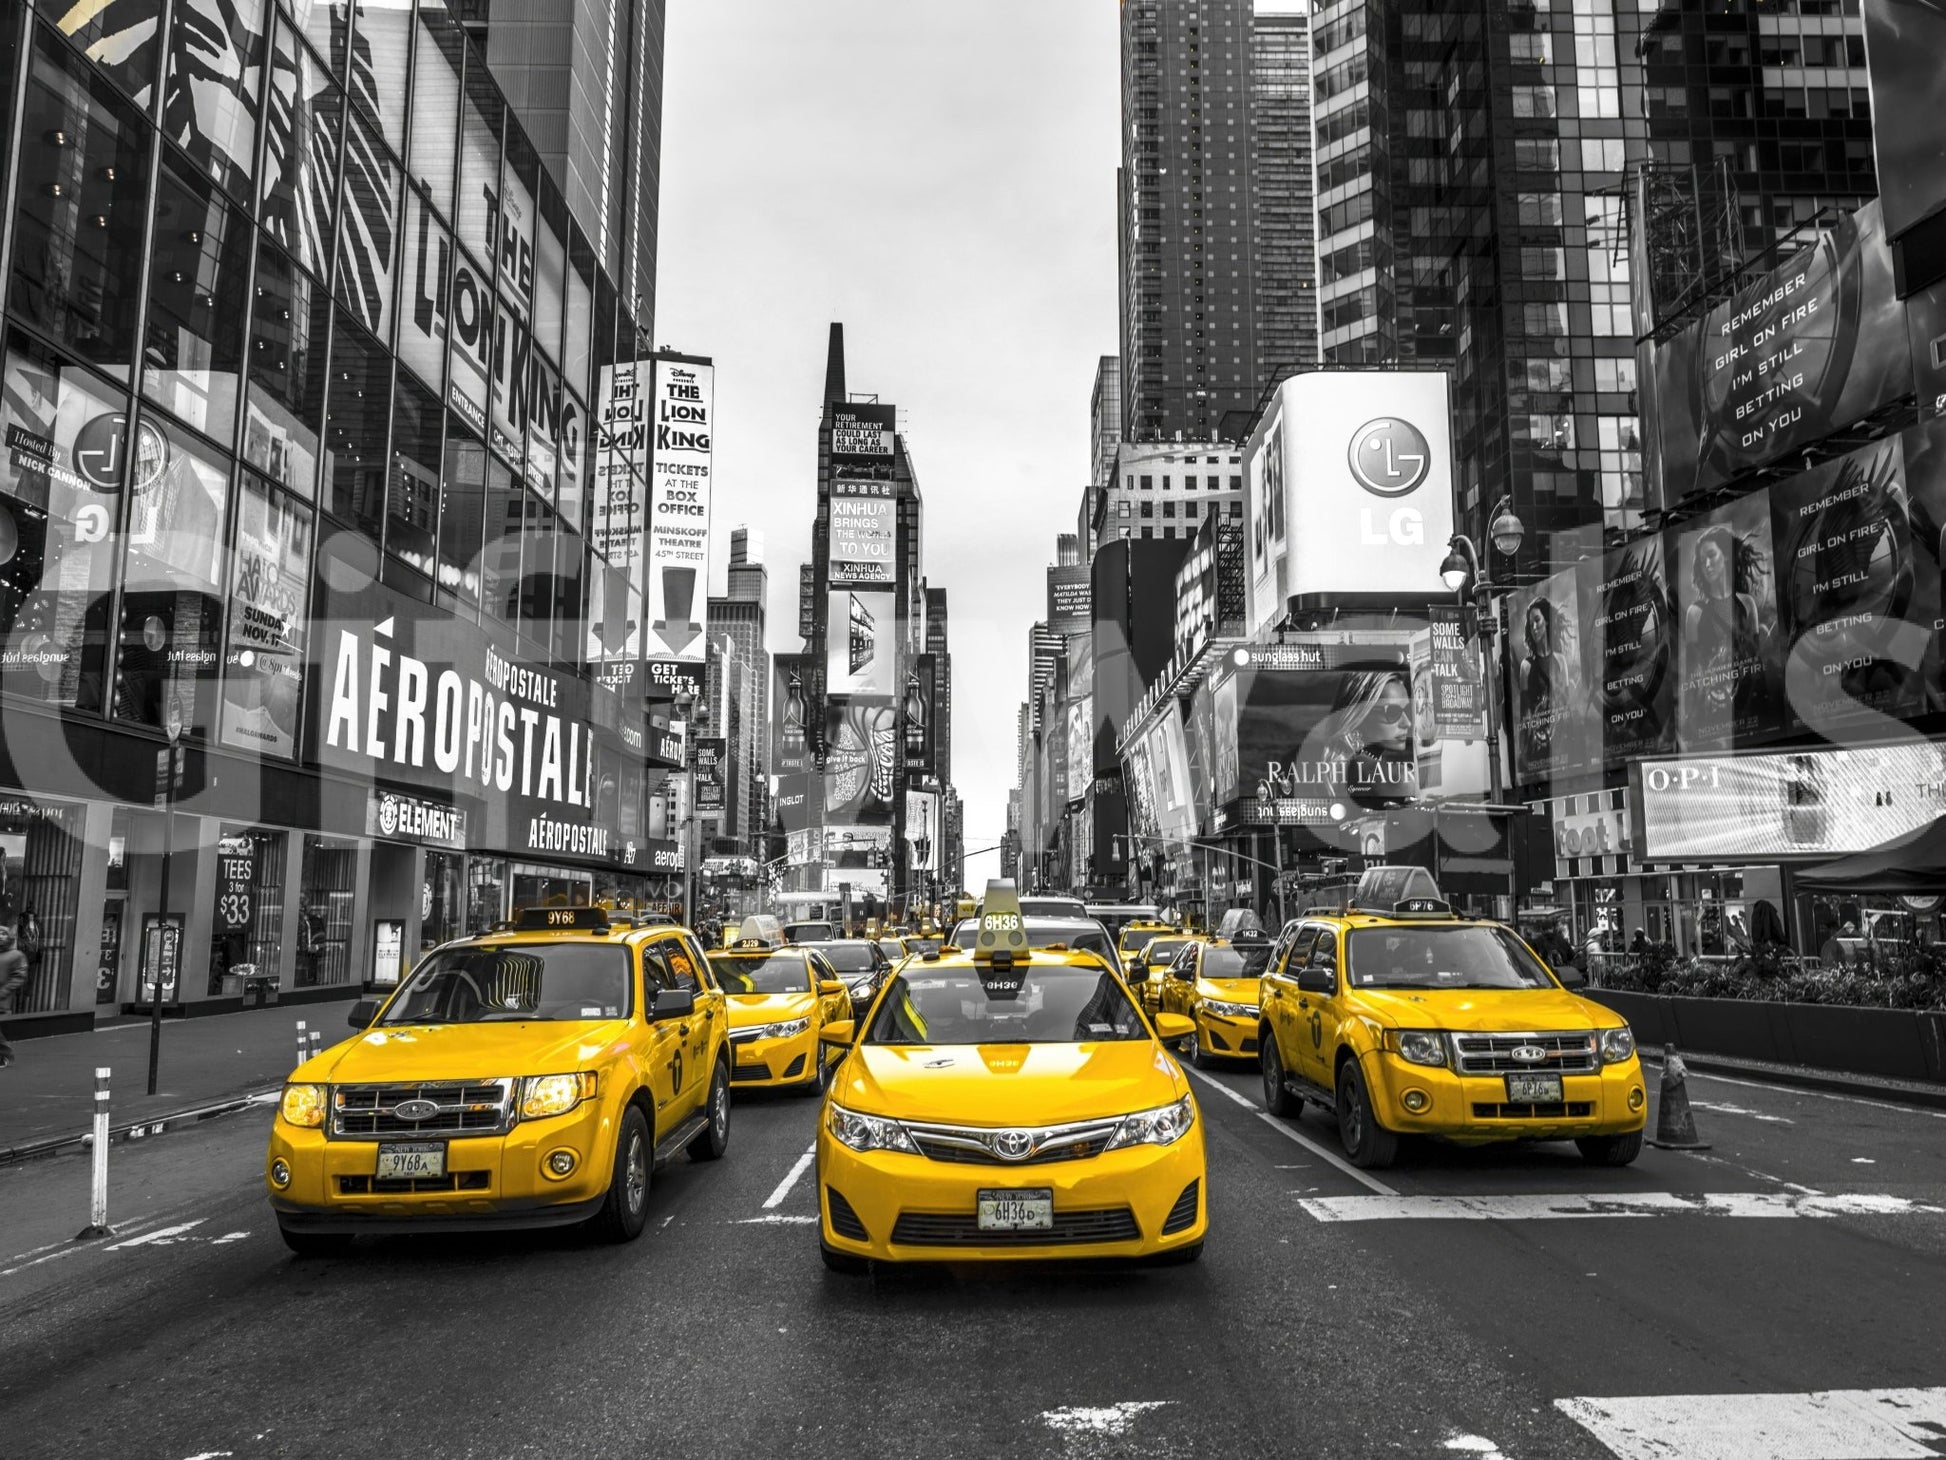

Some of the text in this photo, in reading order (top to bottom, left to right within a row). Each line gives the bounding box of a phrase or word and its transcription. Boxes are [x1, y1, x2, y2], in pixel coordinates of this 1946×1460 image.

[484, 182, 533, 299] THE
[414, 177, 507, 385] LION
[1721, 274, 1806, 337] REMEMBER
[1715, 297, 1818, 370] GIRL ON FIRE
[670, 367, 696, 379] Disney
[1732, 343, 1803, 391] I'M STILL
[508, 302, 578, 468] KING
[666, 383, 699, 399] THE
[1736, 373, 1804, 420] BETTING
[452, 386, 485, 428] ENTRANCE
[661, 399, 705, 422] LION
[835, 413, 857, 422] YOUR
[835, 421, 883, 430] RETIREMENT
[1742, 407, 1802, 448] ON YOU
[12, 429, 47, 454] Hosted
[657, 424, 710, 450] KING
[836, 430, 882, 438] COULD LAST
[836, 438, 881, 446] AS LONG AS
[836, 445, 889, 454] YOUR CAREER
[18, 454, 91, 492] NICK CANNON
[656, 462, 708, 477] TICKETS
[665, 479, 698, 490] AT THE
[836, 484, 891, 496] 新华通讯社
[666, 490, 698, 502] BOX
[1800, 482, 1869, 517] REMEMBER
[658, 502, 705, 516] OFFICE
[833, 502, 888, 516] XINHUA
[834, 518, 879, 528] BRINGS
[1360, 506, 1424, 545] LG
[653, 525, 707, 537] MINSKOFF
[836, 529, 854, 539] THE
[658, 537, 701, 549] THEATRE
[840, 541, 889, 556] TO YOU
[1797, 523, 1879, 559] GIRL ON FIRE
[655, 550, 704, 561] 45TH STREET
[843, 563, 882, 573] XINHUA
[834, 572, 891, 580] NEWS AGENCY
[1596, 570, 1643, 593] REMEMBER
[1813, 570, 1869, 595] I'M STILL
[1594, 602, 1648, 627] GIRL ON FIRE
[1432, 622, 1460, 636] SOME
[1816, 612, 1872, 635] BETTING
[242, 623, 268, 644] NOV.
[1432, 636, 1465, 650] WALLS
[1605, 640, 1642, 658] I'M STILL
[259, 655, 268, 671] @
[1251, 650, 1321, 665] sunglass hut
[1433, 650, 1453, 662] CAN
[651, 662, 678, 676] GET
[1433, 663, 1458, 677] TALK
[1823, 655, 1872, 676] ON YOU
[485, 643, 557, 709] AÉROPOSTALE
[1607, 674, 1644, 691] BETTING
[1681, 669, 1739, 692] CATCHING
[1440, 684, 1473, 696] SPOTLIGHT
[1441, 698, 1473, 709] BROADWAY
[1517, 715, 1555, 731] CATCHING
[1611, 709, 1644, 724] ON YOU
[698, 748, 715, 757] SOME
[826, 755, 865, 764] give it back
[698, 756, 718, 766] WALLS
[698, 773, 713, 782] TALK
[1267, 761, 1347, 784] RALPH
[779, 794, 804, 807] INGLOT
[399, 806, 458, 841] ELEMENT
[528, 812, 608, 857] AÉROPOSTALE
[1555, 818, 1610, 857] foot
[223, 859, 252, 880] TEES
[228, 881, 244, 892] 3 for
[220, 895, 250, 924] $33
[1409, 900, 1434, 911] 6P76
[548, 910, 575, 925] 9Y68
[984, 914, 1019, 931] 6H36
[1242, 930, 1258, 938] 1K22
